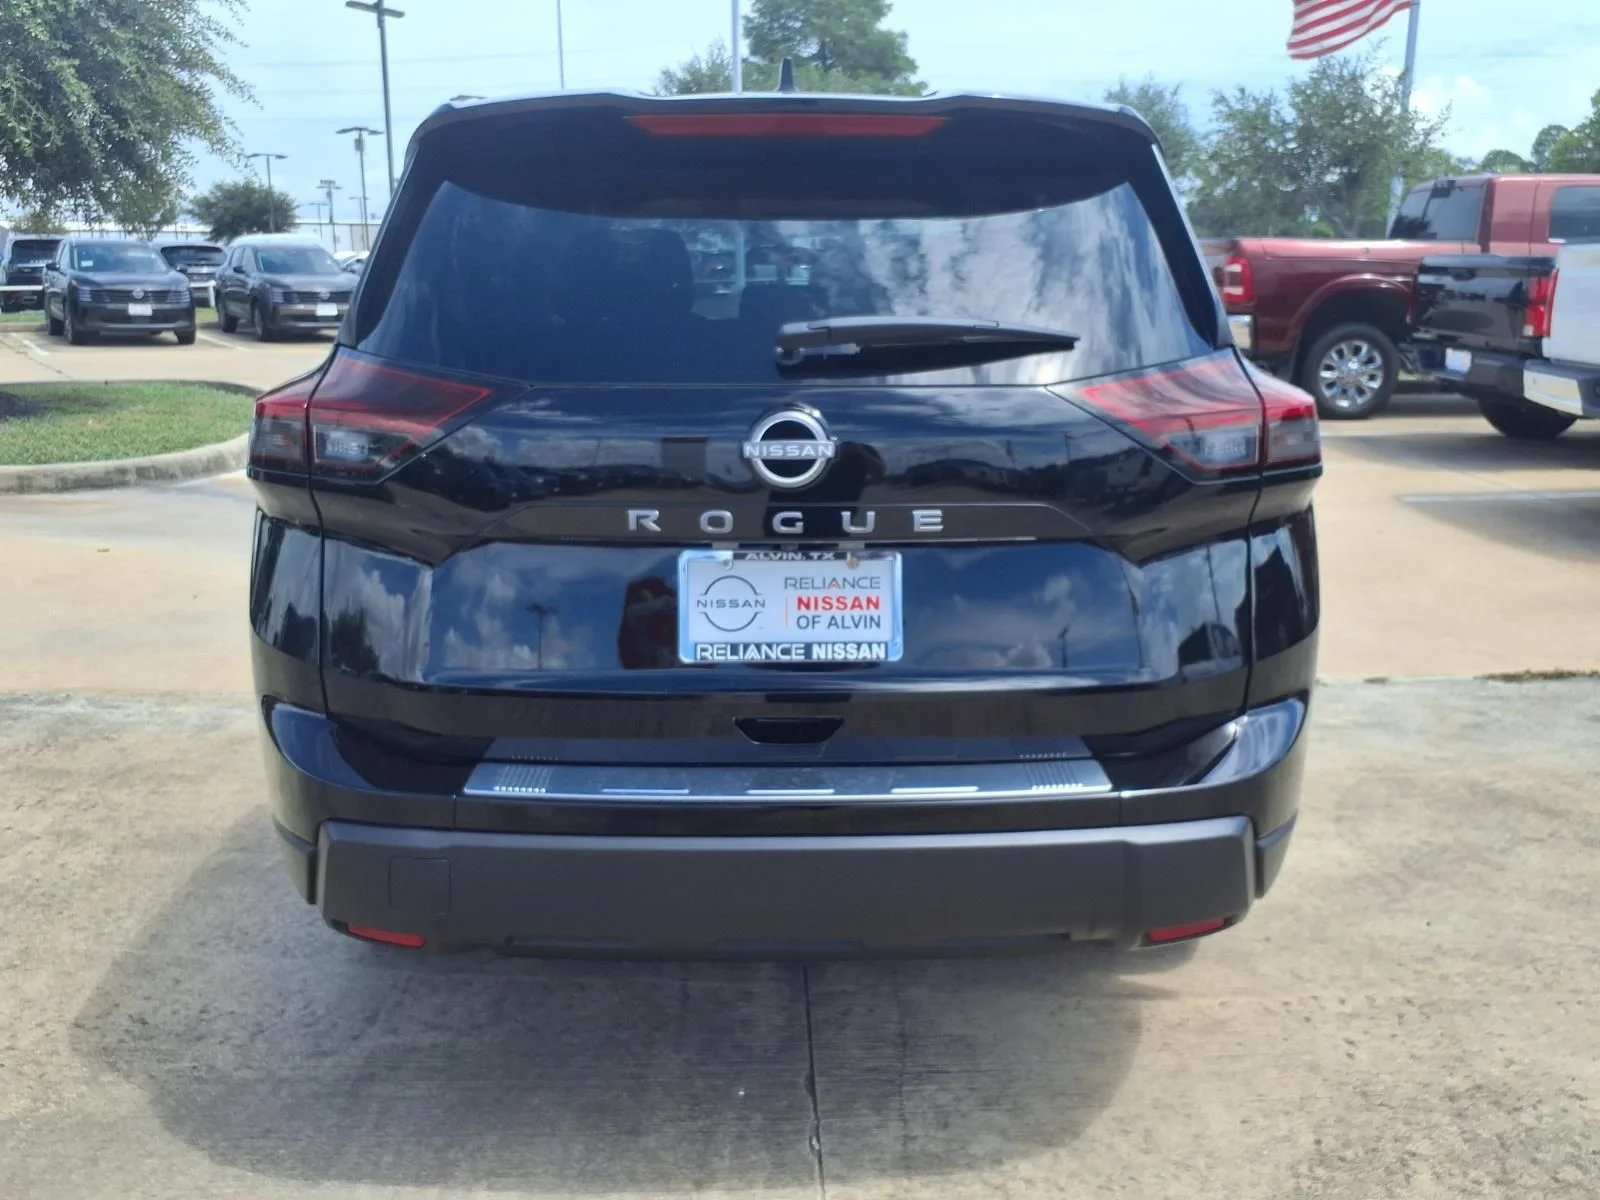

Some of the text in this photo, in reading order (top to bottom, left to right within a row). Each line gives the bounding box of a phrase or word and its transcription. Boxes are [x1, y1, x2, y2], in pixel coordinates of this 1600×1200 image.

[745, 445, 833, 457] NISSAN
[627, 509, 944, 533] ROGUE
[809, 551, 837, 560] TX
[784, 576, 881, 589] RELIANCE
[696, 599, 766, 609] NISSAN
[797, 596, 880, 610] NISSAN
[797, 614, 881, 630] OF ALVIN
[696, 643, 886, 660] RELIANCE NISSAN
